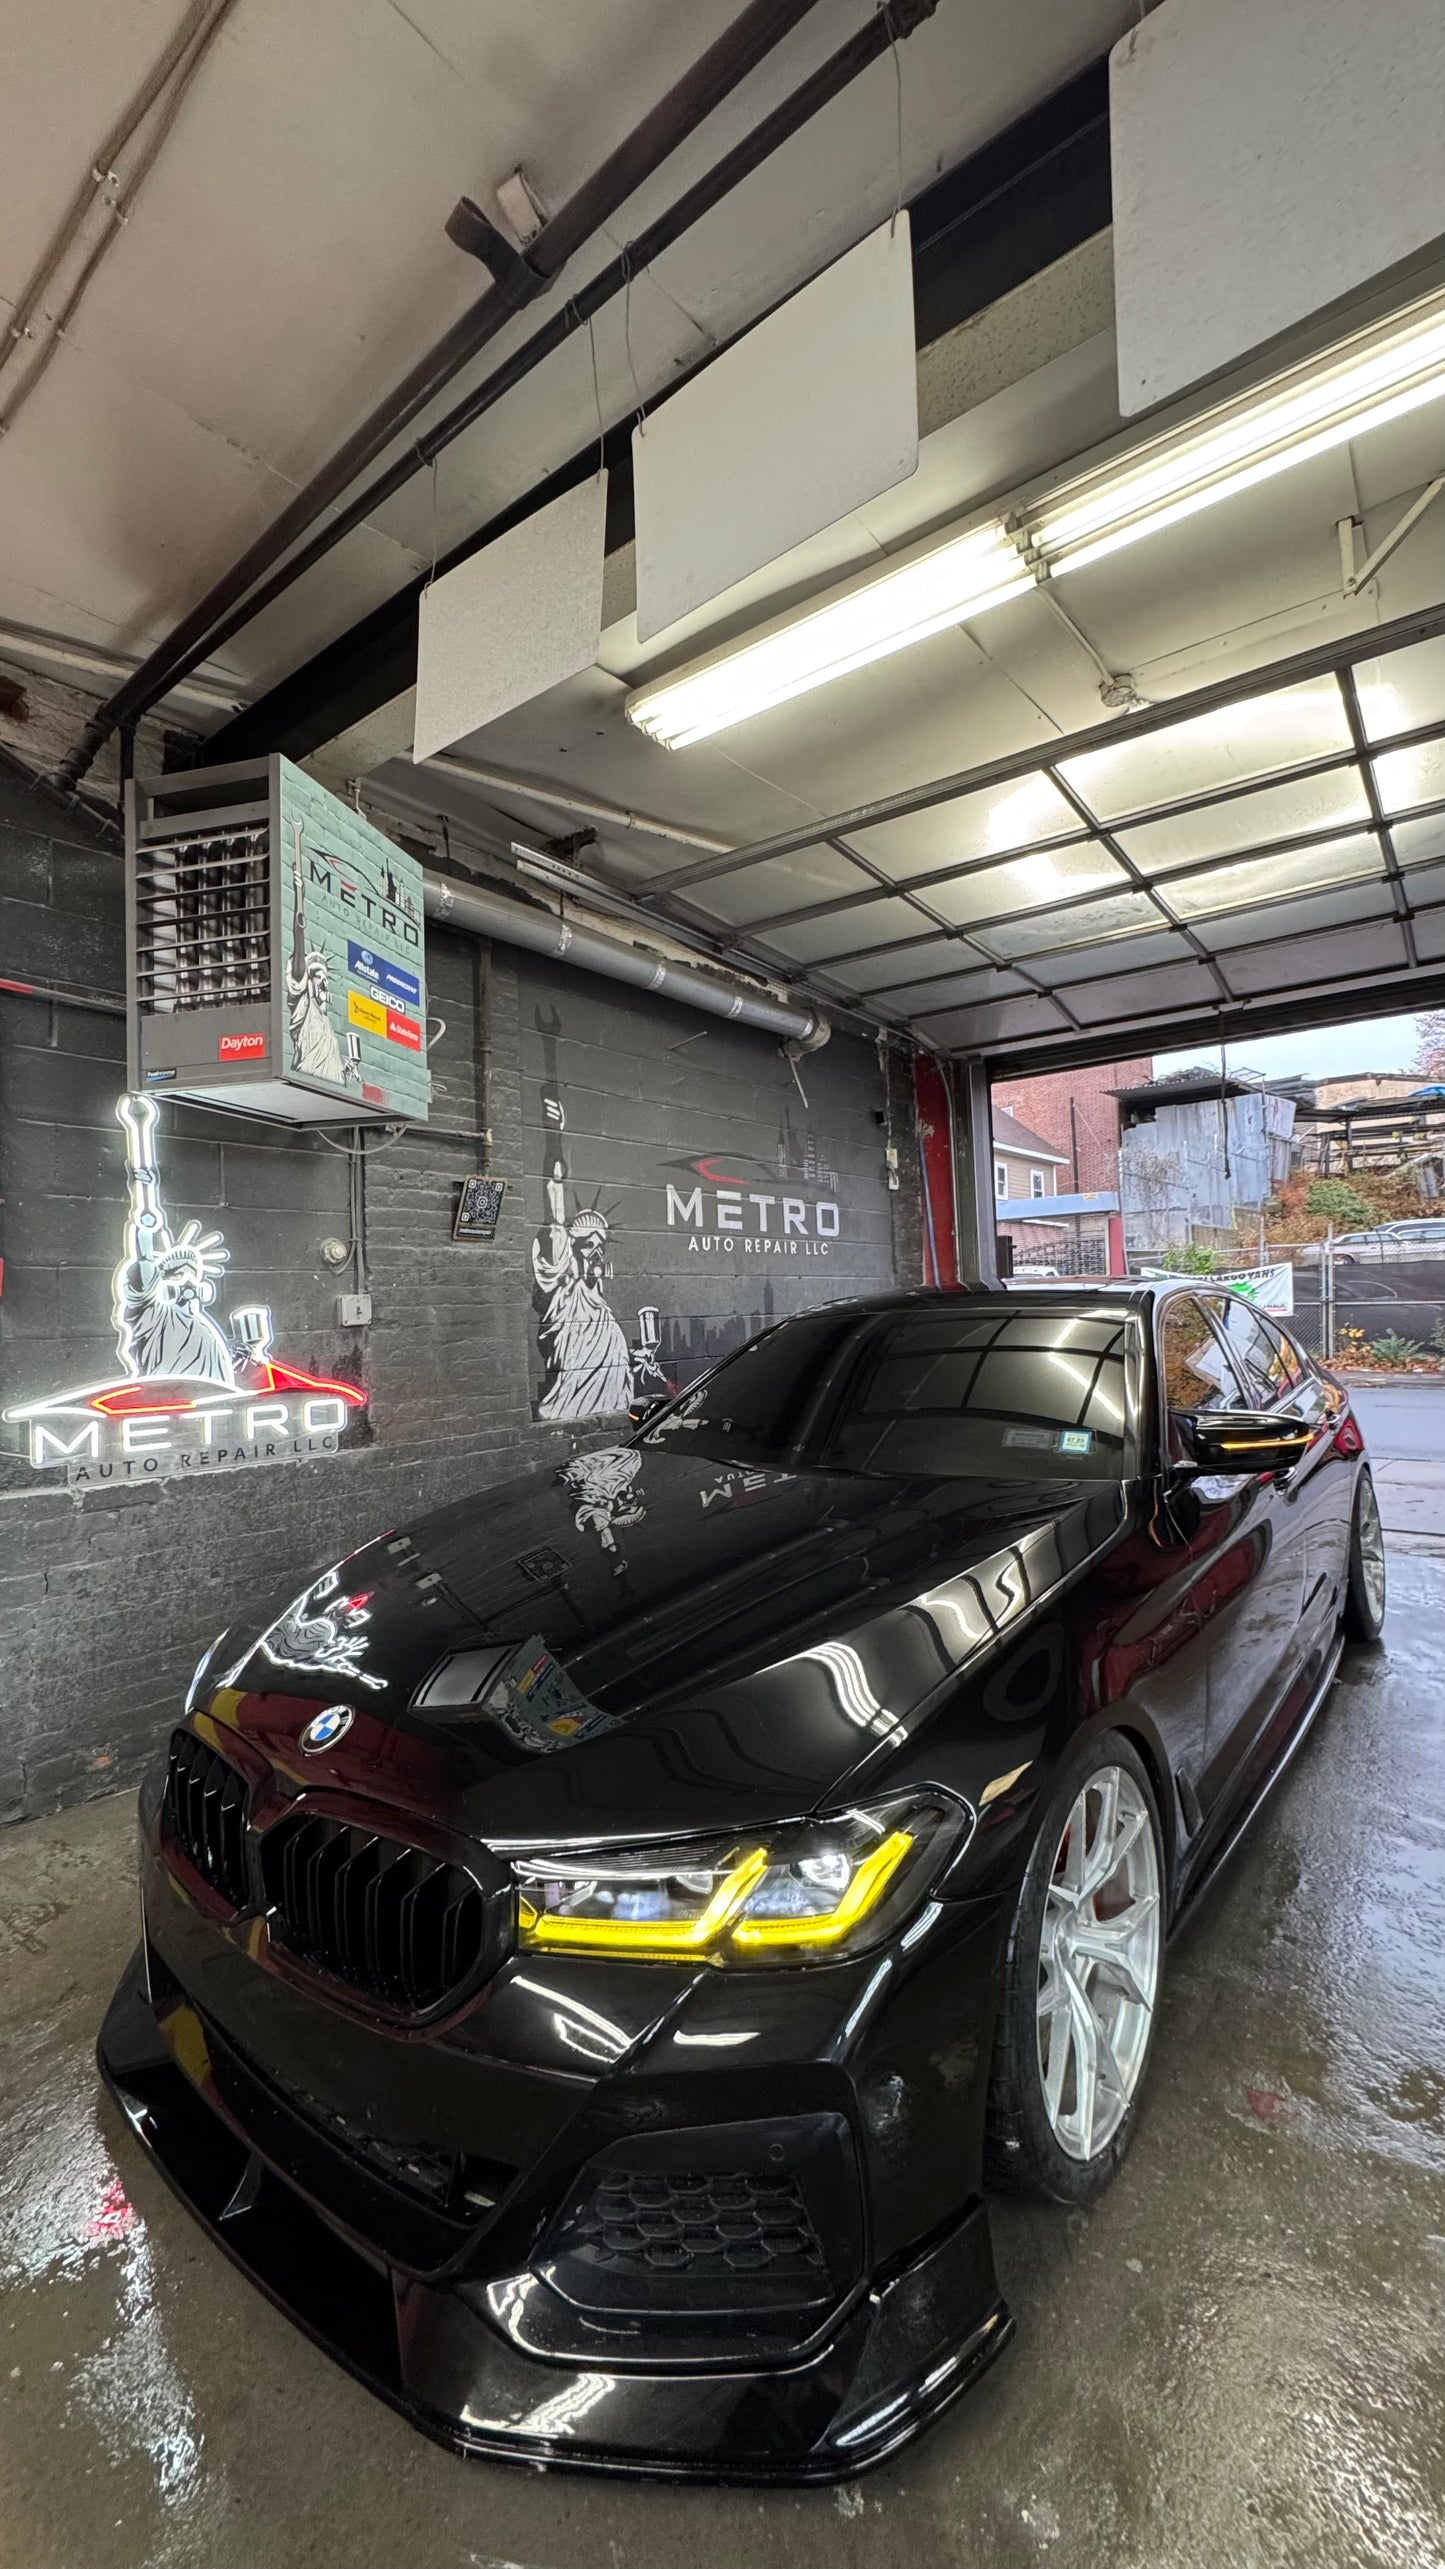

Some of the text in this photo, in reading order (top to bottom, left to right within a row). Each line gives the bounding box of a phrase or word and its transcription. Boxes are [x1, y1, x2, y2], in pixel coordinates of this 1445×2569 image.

[310, 861, 418, 947] METRO
[370, 986, 405, 1013] GEICO
[221, 1036, 263, 1051] Dayton
[666, 1184, 840, 1237] METRO
[688, 1235, 829, 1256] AUTO REPAIR LLC
[35, 1397, 346, 1464] METRO
[75, 1436, 334, 1482] AUTO REPAIR LLC
